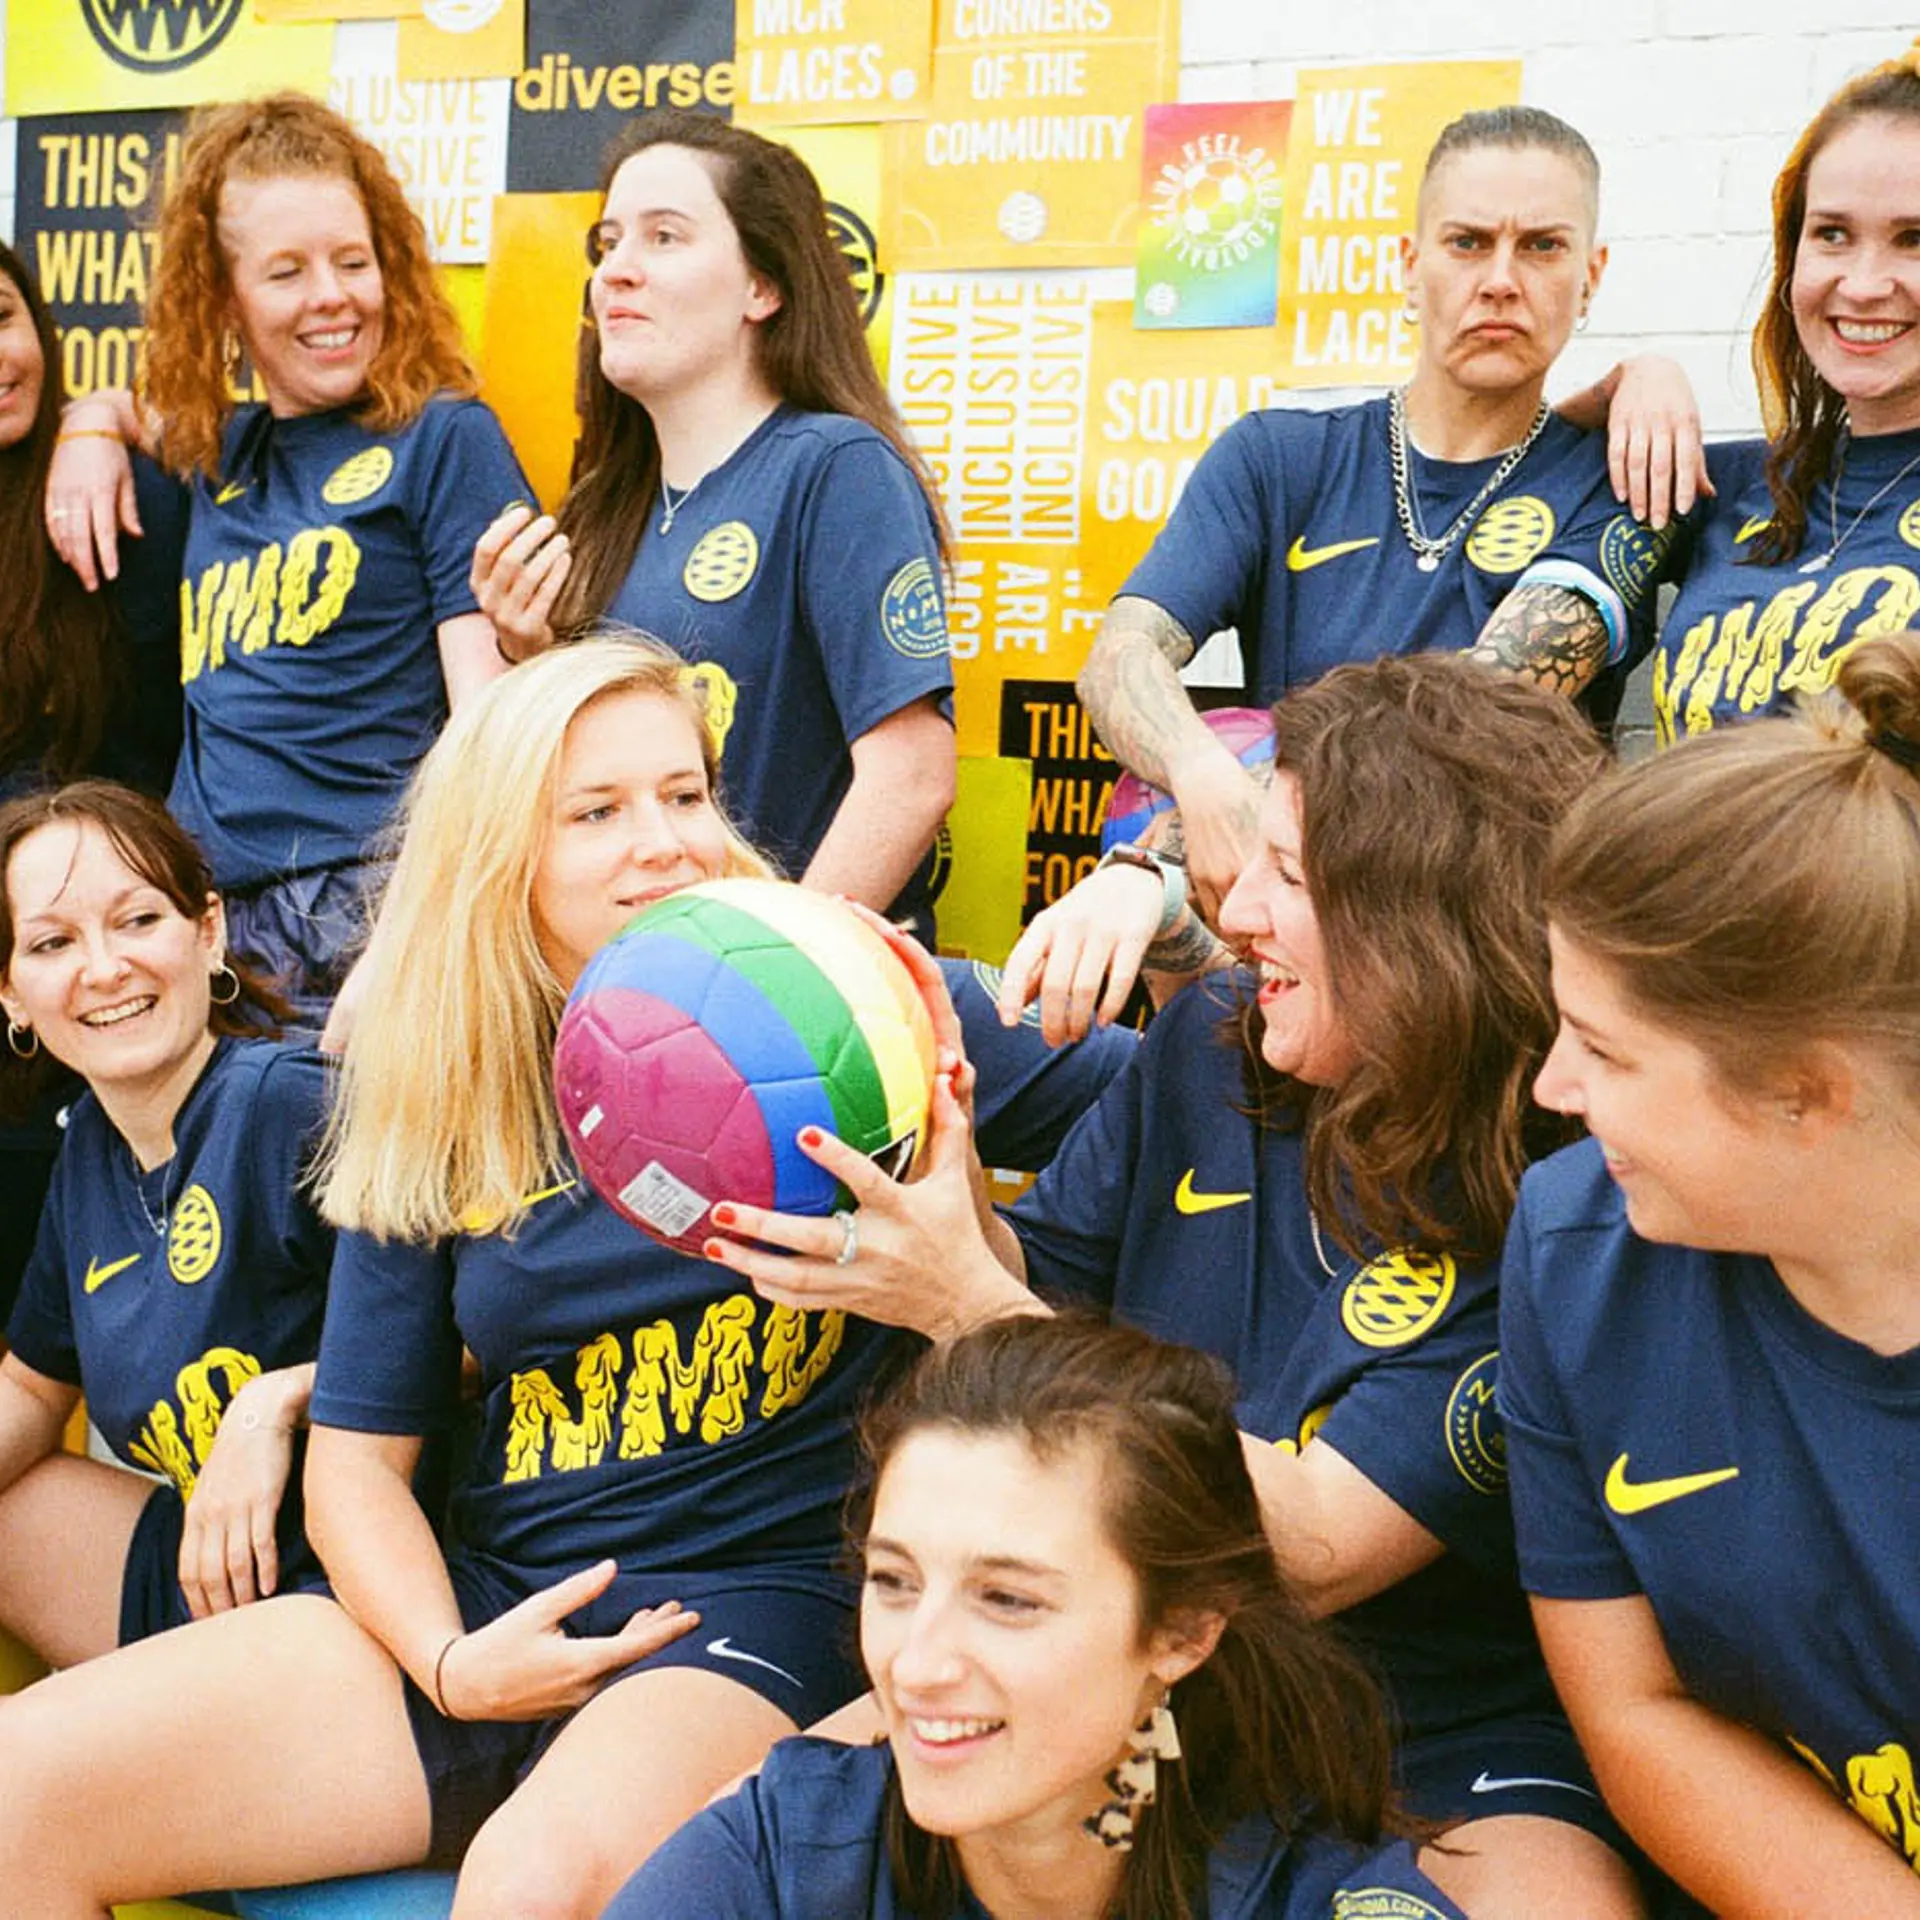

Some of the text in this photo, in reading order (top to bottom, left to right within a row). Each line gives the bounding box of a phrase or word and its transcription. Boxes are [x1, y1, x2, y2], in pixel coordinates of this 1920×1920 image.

[954, 0, 1112, 37] CORNERS
[514, 53, 736, 111] diverse
[971, 51, 1088, 100] OF THE
[925, 115, 1132, 166] COMMUNITY
[1313, 88, 1384, 147] WE
[39, 134, 150, 209] THIS
[1303, 160, 1401, 220] ARE
[1298, 234, 1404, 295] MCR
[960, 283, 1023, 537] INCLUSIVE
[1021, 283, 1088, 537] INCLUSIVE
[994, 560, 1050, 654] ARE
